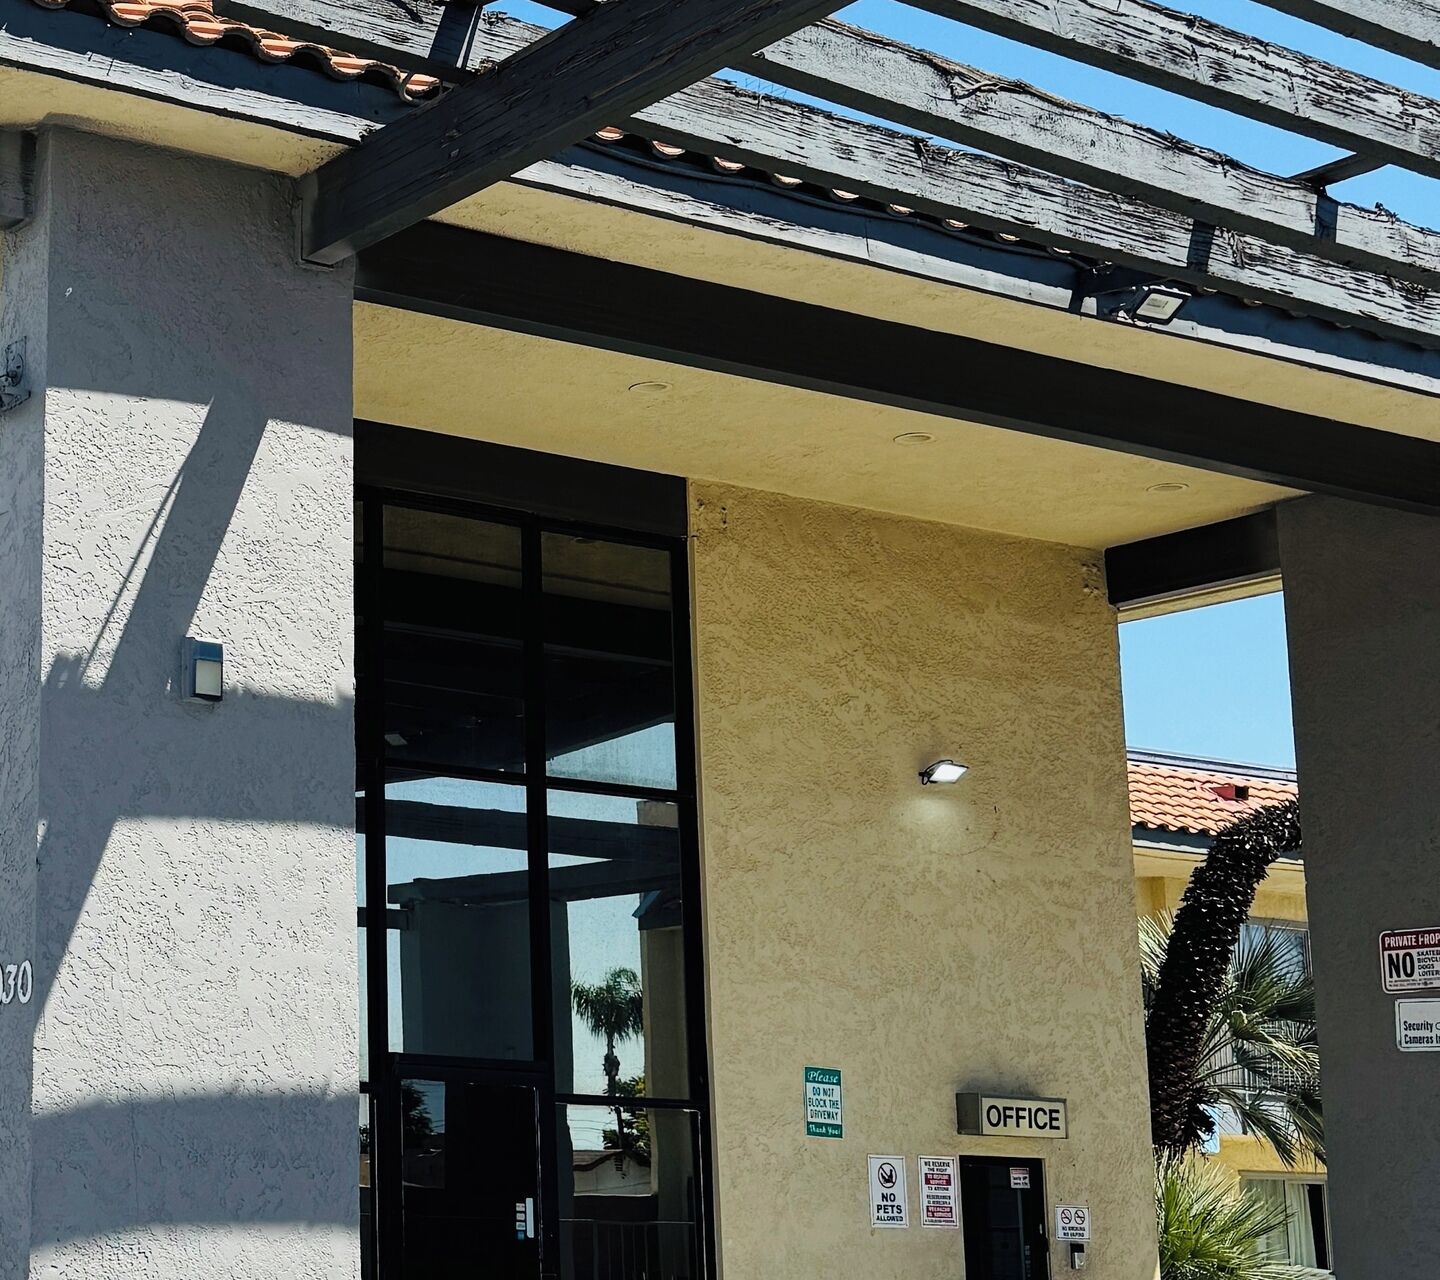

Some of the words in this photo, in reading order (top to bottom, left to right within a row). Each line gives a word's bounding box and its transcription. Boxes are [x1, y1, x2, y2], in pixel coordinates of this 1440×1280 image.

[1384, 934, 1417, 948] PRIVATE
[1387, 951, 1415, 979] NO
[1403, 1020, 1434, 1033] Security
[1404, 1033, 1434, 1045] Cameras
[807, 1069, 839, 1083] Please
[812, 1086, 821, 1097] DO
[822, 1087, 835, 1098] NOT
[808, 1097, 828, 1108] BLOCK
[828, 1099, 840, 1110] THE
[810, 1108, 839, 1121] DRIVEWAY
[986, 1104, 1061, 1131] OFFICE
[809, 1123, 827, 1134] Thank
[881, 1192, 896, 1203] NO
[876, 1204, 903, 1215] PETS
